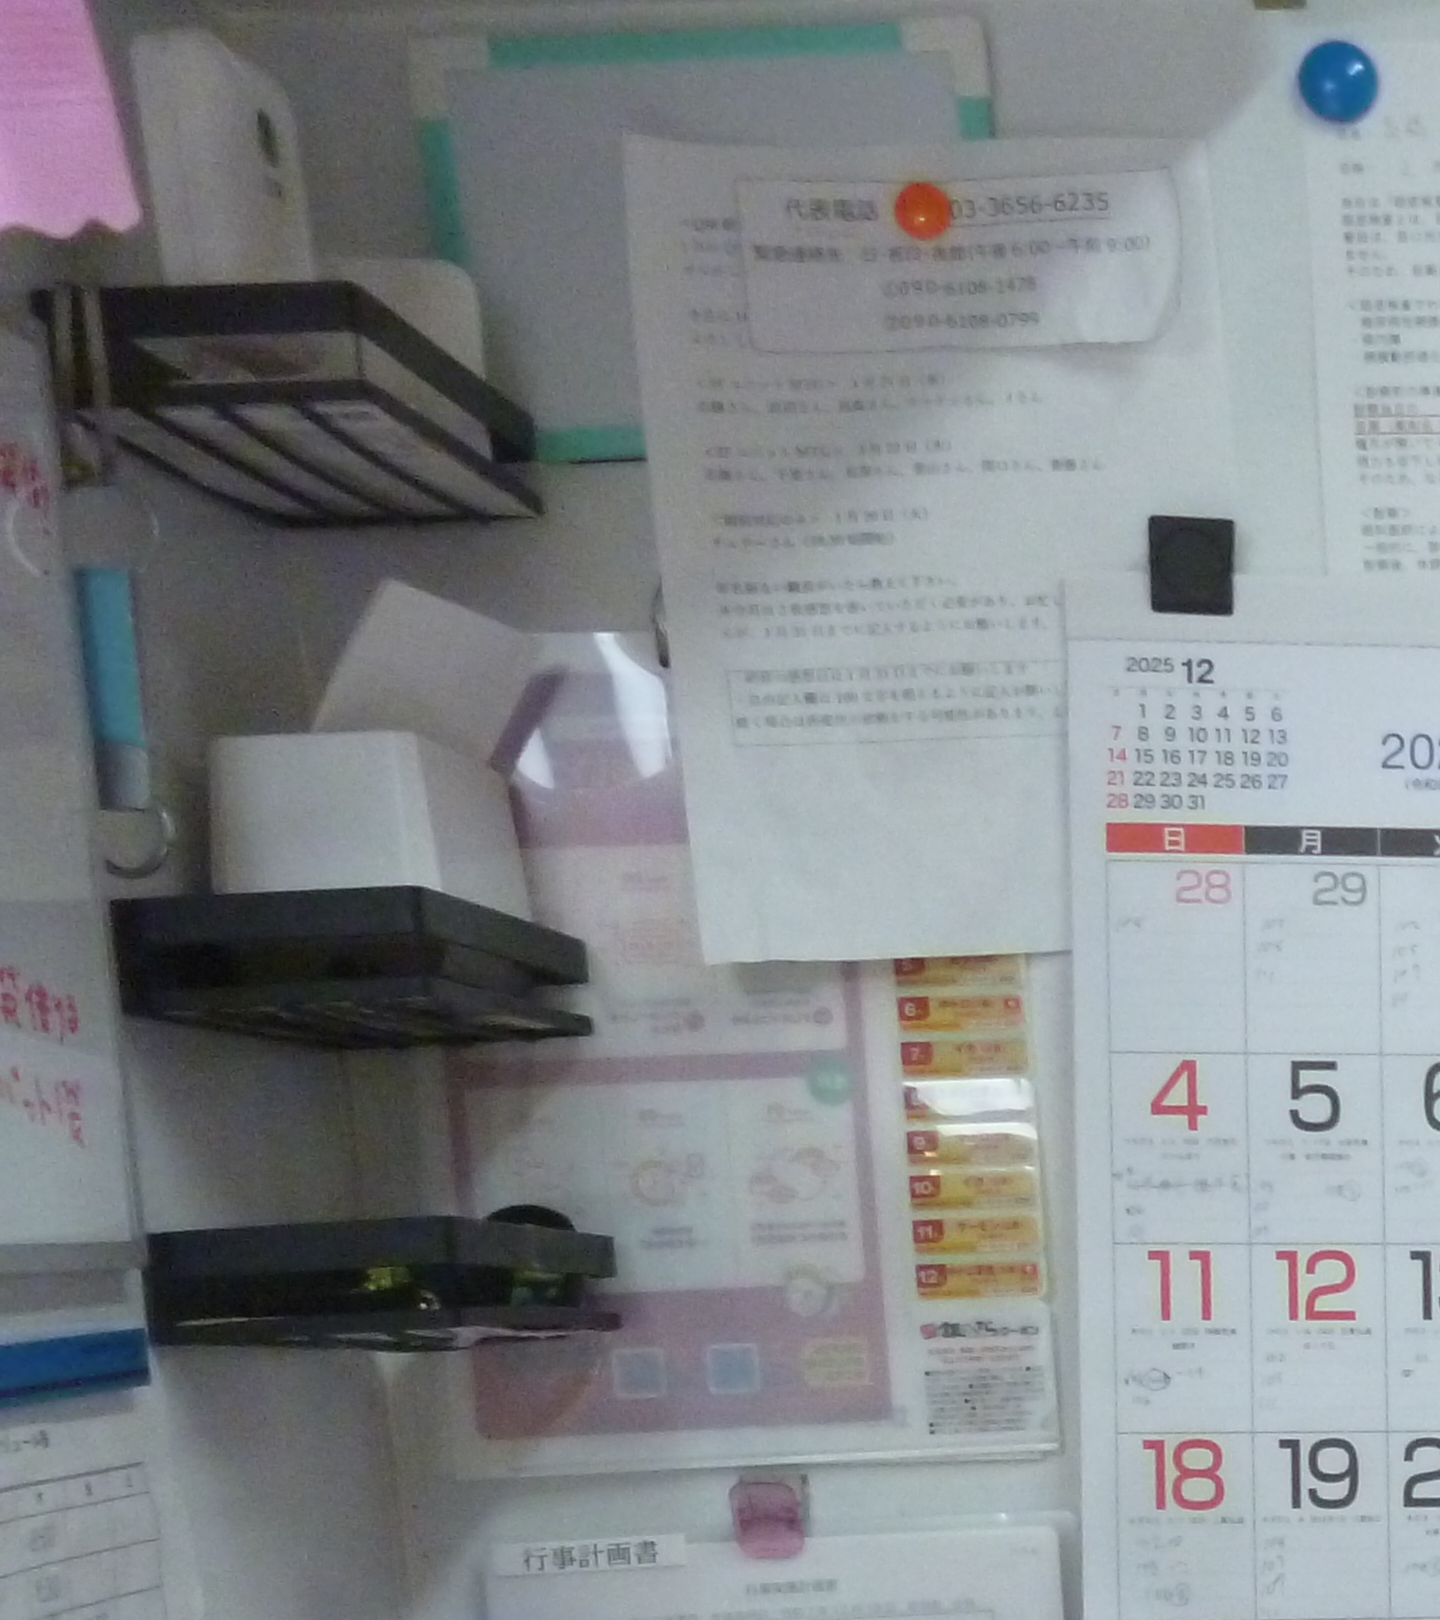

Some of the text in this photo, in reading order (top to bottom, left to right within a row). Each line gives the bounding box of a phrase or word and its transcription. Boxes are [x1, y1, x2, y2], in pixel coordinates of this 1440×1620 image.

[1126, 657, 1214, 684] 2025 12
[1139, 704, 1282, 722] 1 2 3 4 5 6
[1112, 725, 1287, 745] 7 8 9 10 11 12 13
[1108, 748, 1288, 767] 14 15 16 17 18 19 20
[1107, 770, 1288, 789] 21 22 23 24 25 26 27
[1107, 793, 1205, 810] 28 29 30 31
[1163, 828, 1184, 851] 日
[1299, 829, 1321, 853] 月
[1176, 870, 1231, 904] 28
[1313, 871, 1367, 906] 29
[1151, 1060, 1207, 1130] 4
[1290, 1061, 1340, 1132] 5
[1148, 1251, 1211, 1320] 11
[1276, 1250, 1355, 1320] 12
[1143, 1439, 1224, 1510] 18
[1279, 1438, 1358, 1509] 19
[524, 1541, 658, 1571] 行事計画書
